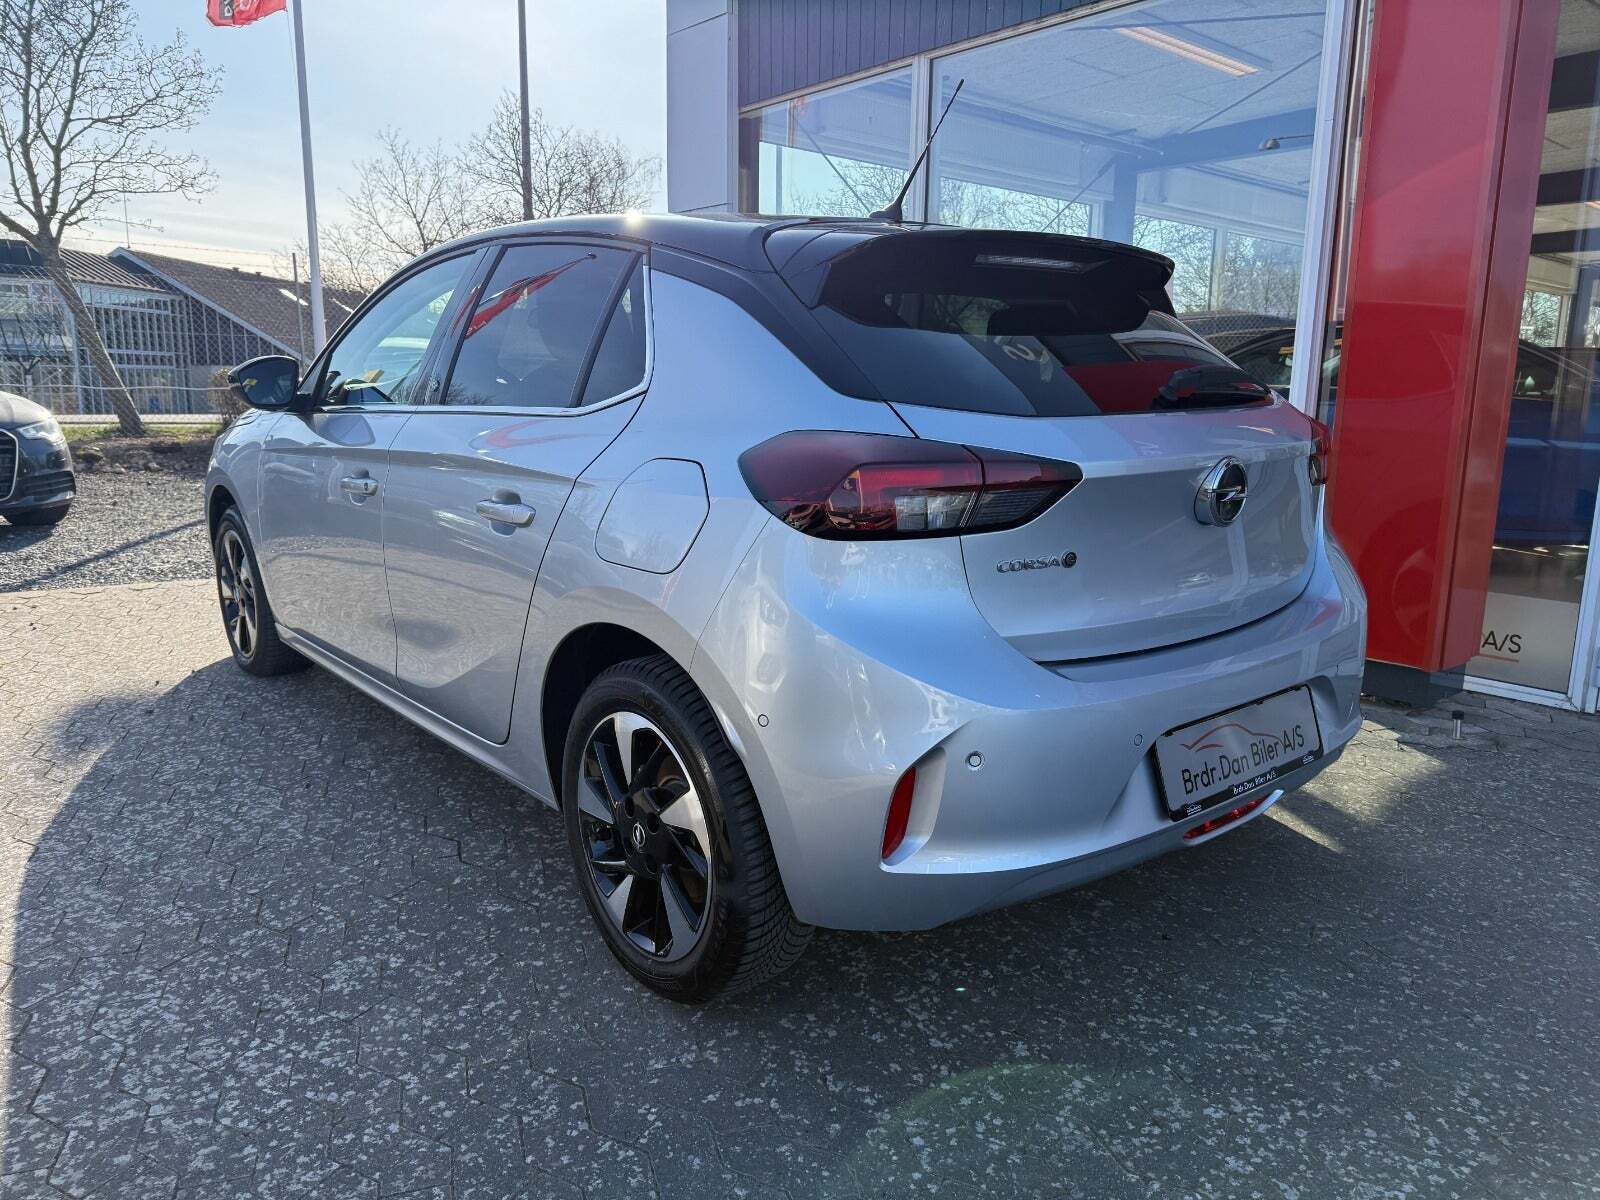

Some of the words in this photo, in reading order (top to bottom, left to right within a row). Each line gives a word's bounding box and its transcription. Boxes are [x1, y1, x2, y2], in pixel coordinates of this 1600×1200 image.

[1481, 630, 1522, 653] A/S
[1250, 739, 1280, 767] Biler
[1282, 725, 1305, 754] A/S
